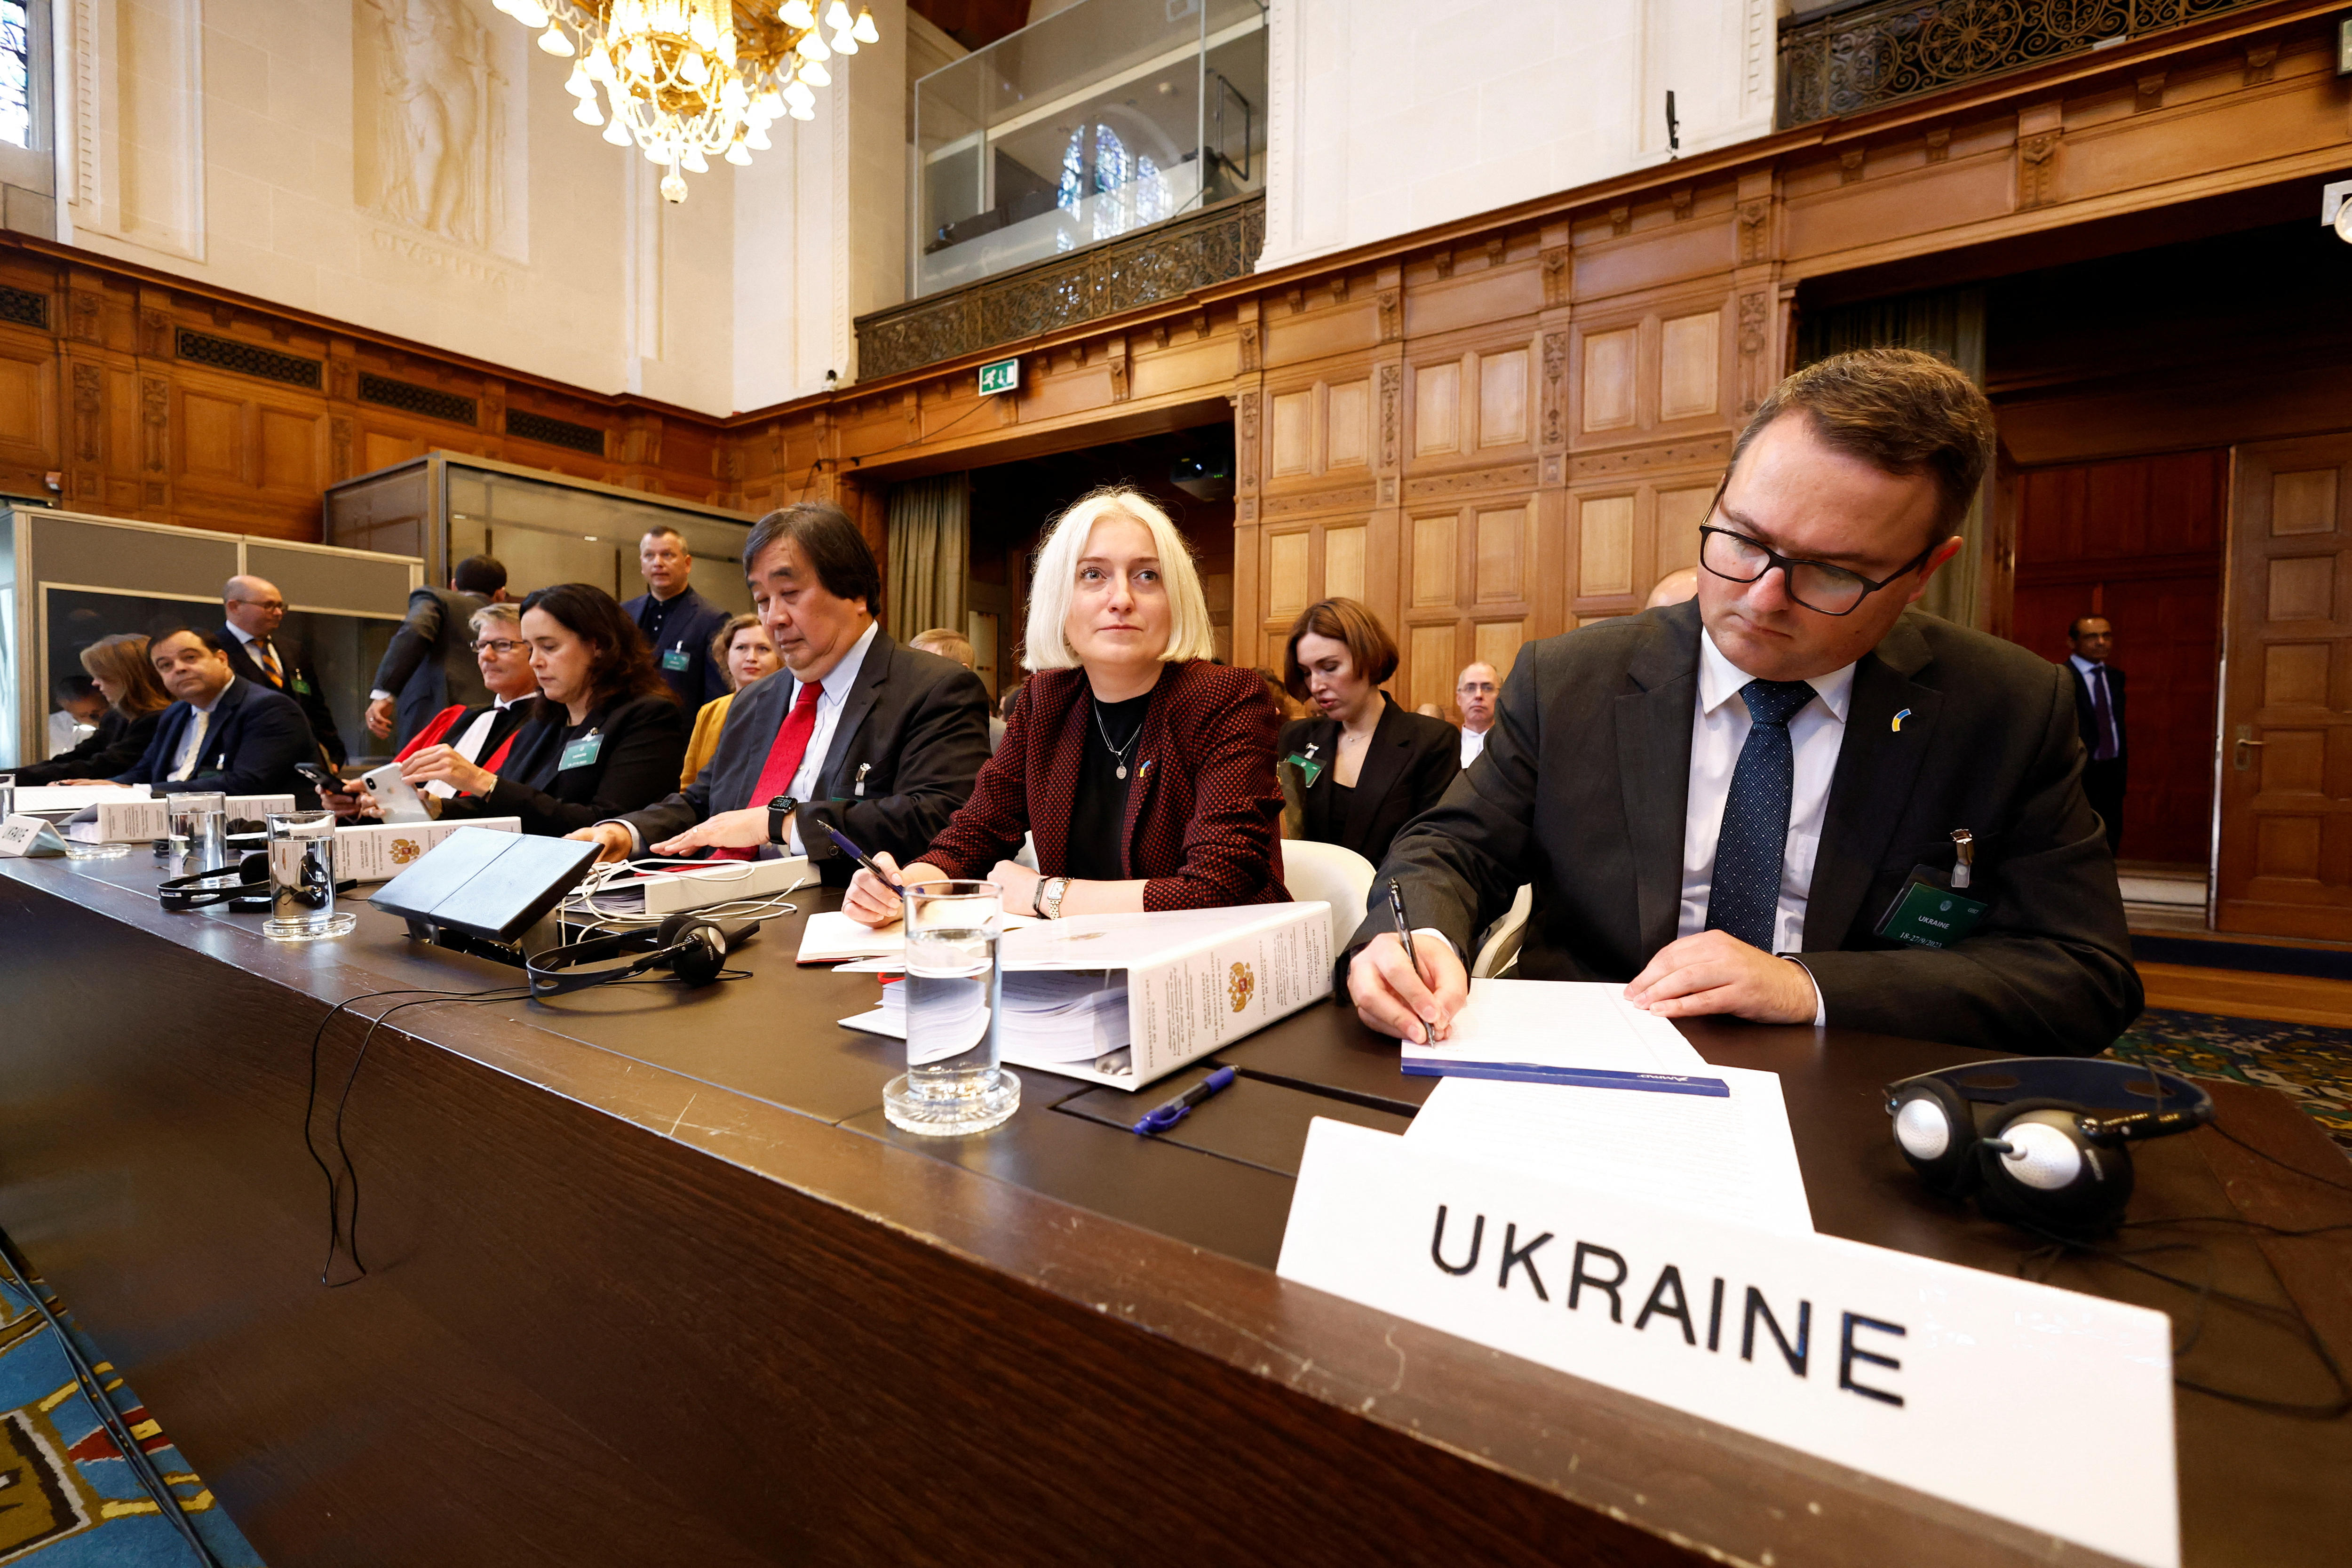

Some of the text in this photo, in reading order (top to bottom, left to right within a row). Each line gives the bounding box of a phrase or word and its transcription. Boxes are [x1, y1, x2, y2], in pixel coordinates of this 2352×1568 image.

[1918, 915, 1950, 929] UKRAINE
[1899, 932, 1942, 948] 18-27/9/2023
[1430, 1205, 1906, 1407] UKRAINE
